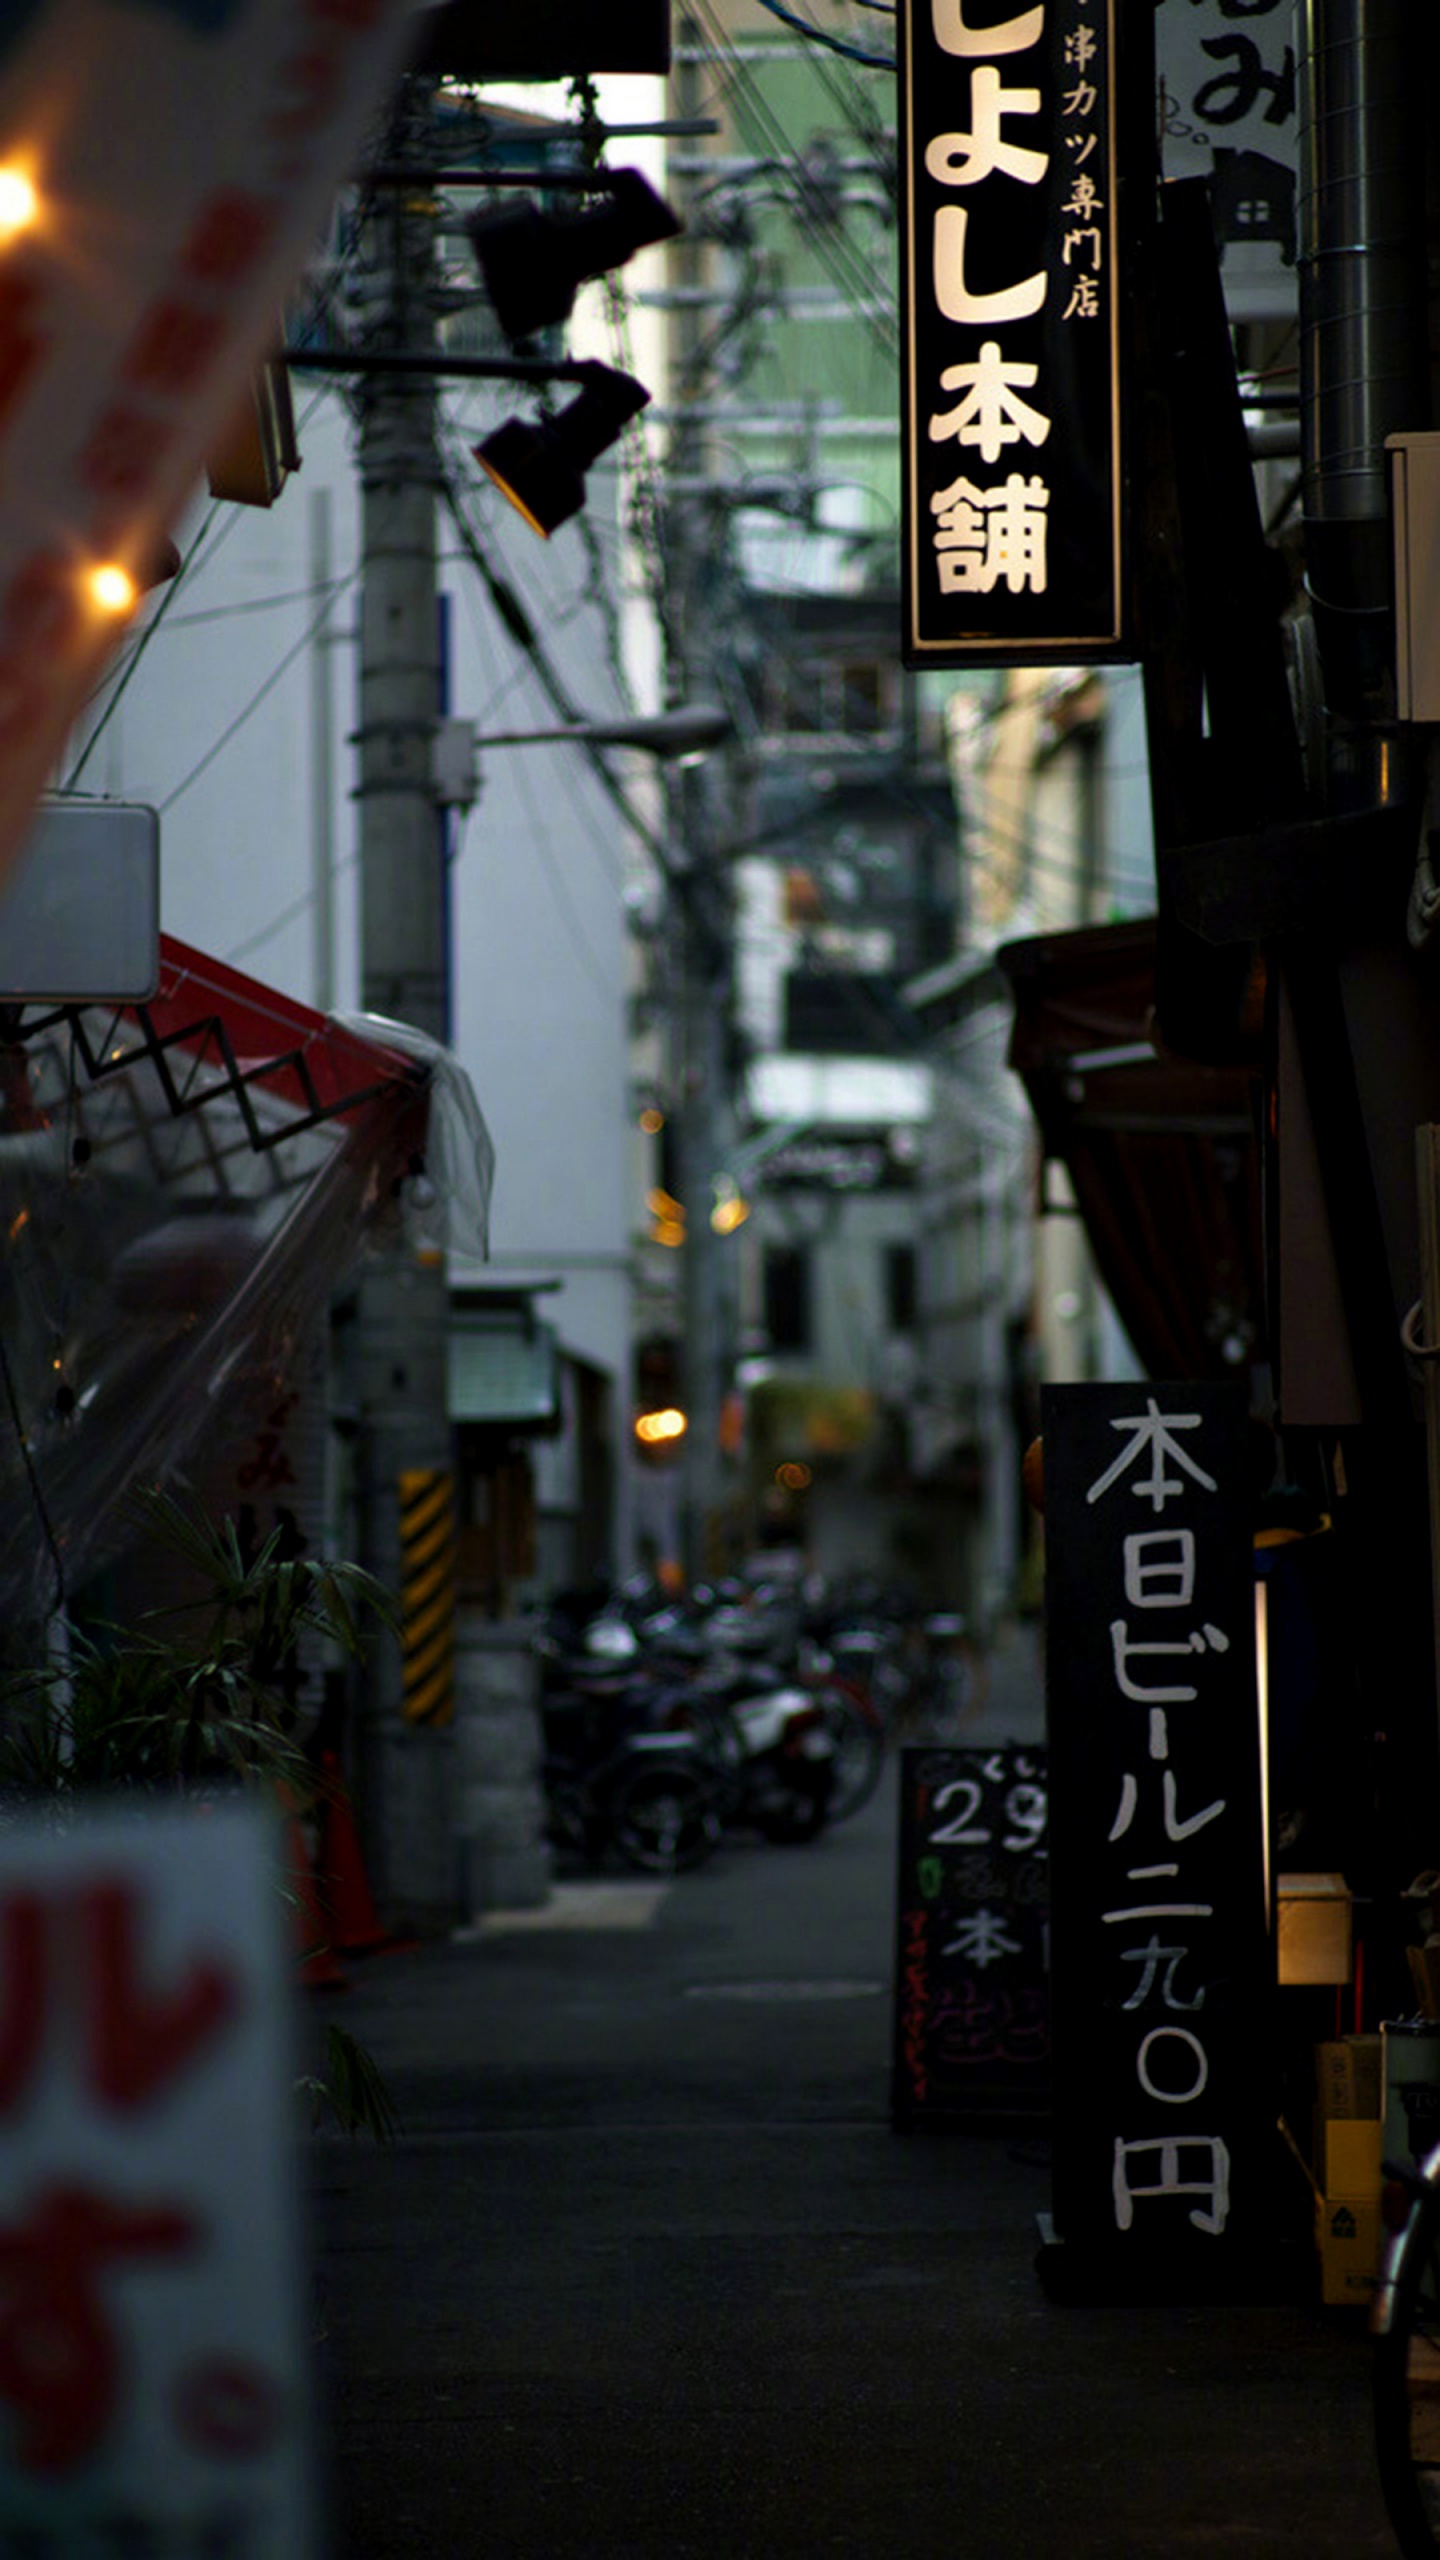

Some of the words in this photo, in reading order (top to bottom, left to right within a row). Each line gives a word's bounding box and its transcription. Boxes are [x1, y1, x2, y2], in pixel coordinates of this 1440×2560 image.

[1060, 23, 1105, 322] 串カツ専門店
